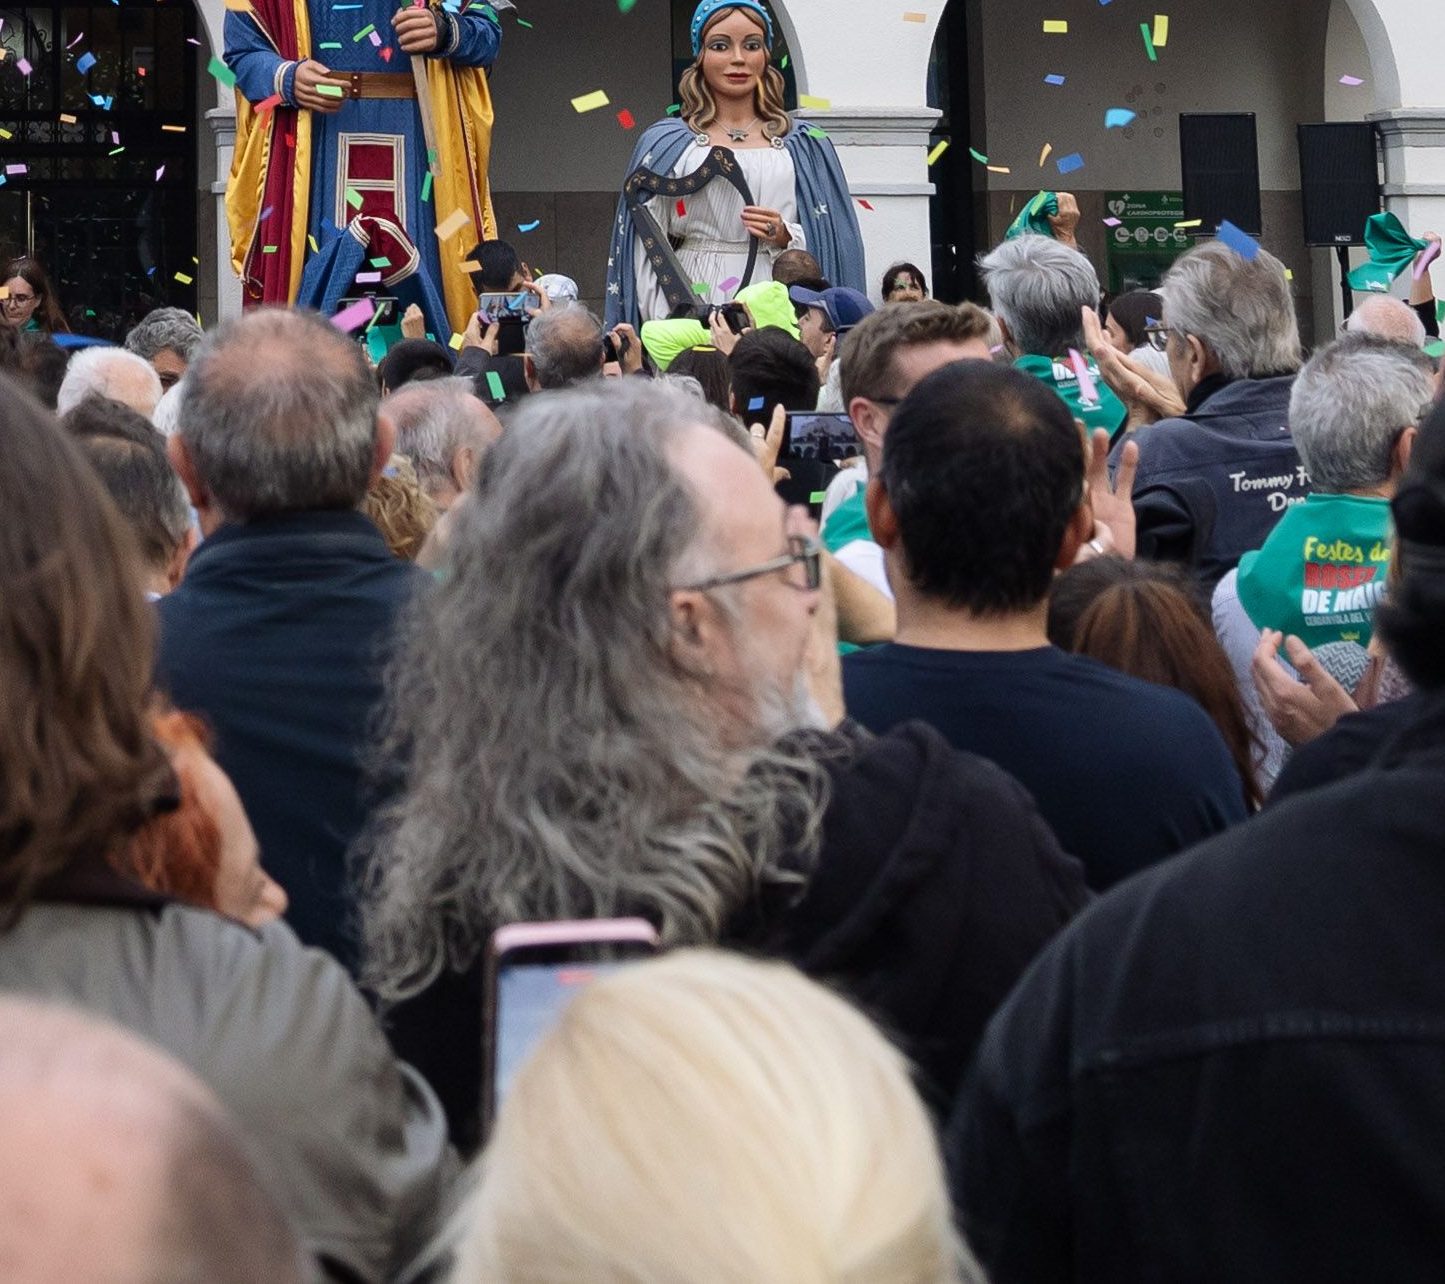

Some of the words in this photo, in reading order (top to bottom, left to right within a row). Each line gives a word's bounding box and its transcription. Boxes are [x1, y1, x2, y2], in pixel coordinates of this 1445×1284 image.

[1229, 471, 1293, 492] Tommy
[1267, 492, 1307, 512] Den
[1303, 536, 1364, 563] Festes
[1302, 589, 1332, 615] DE
